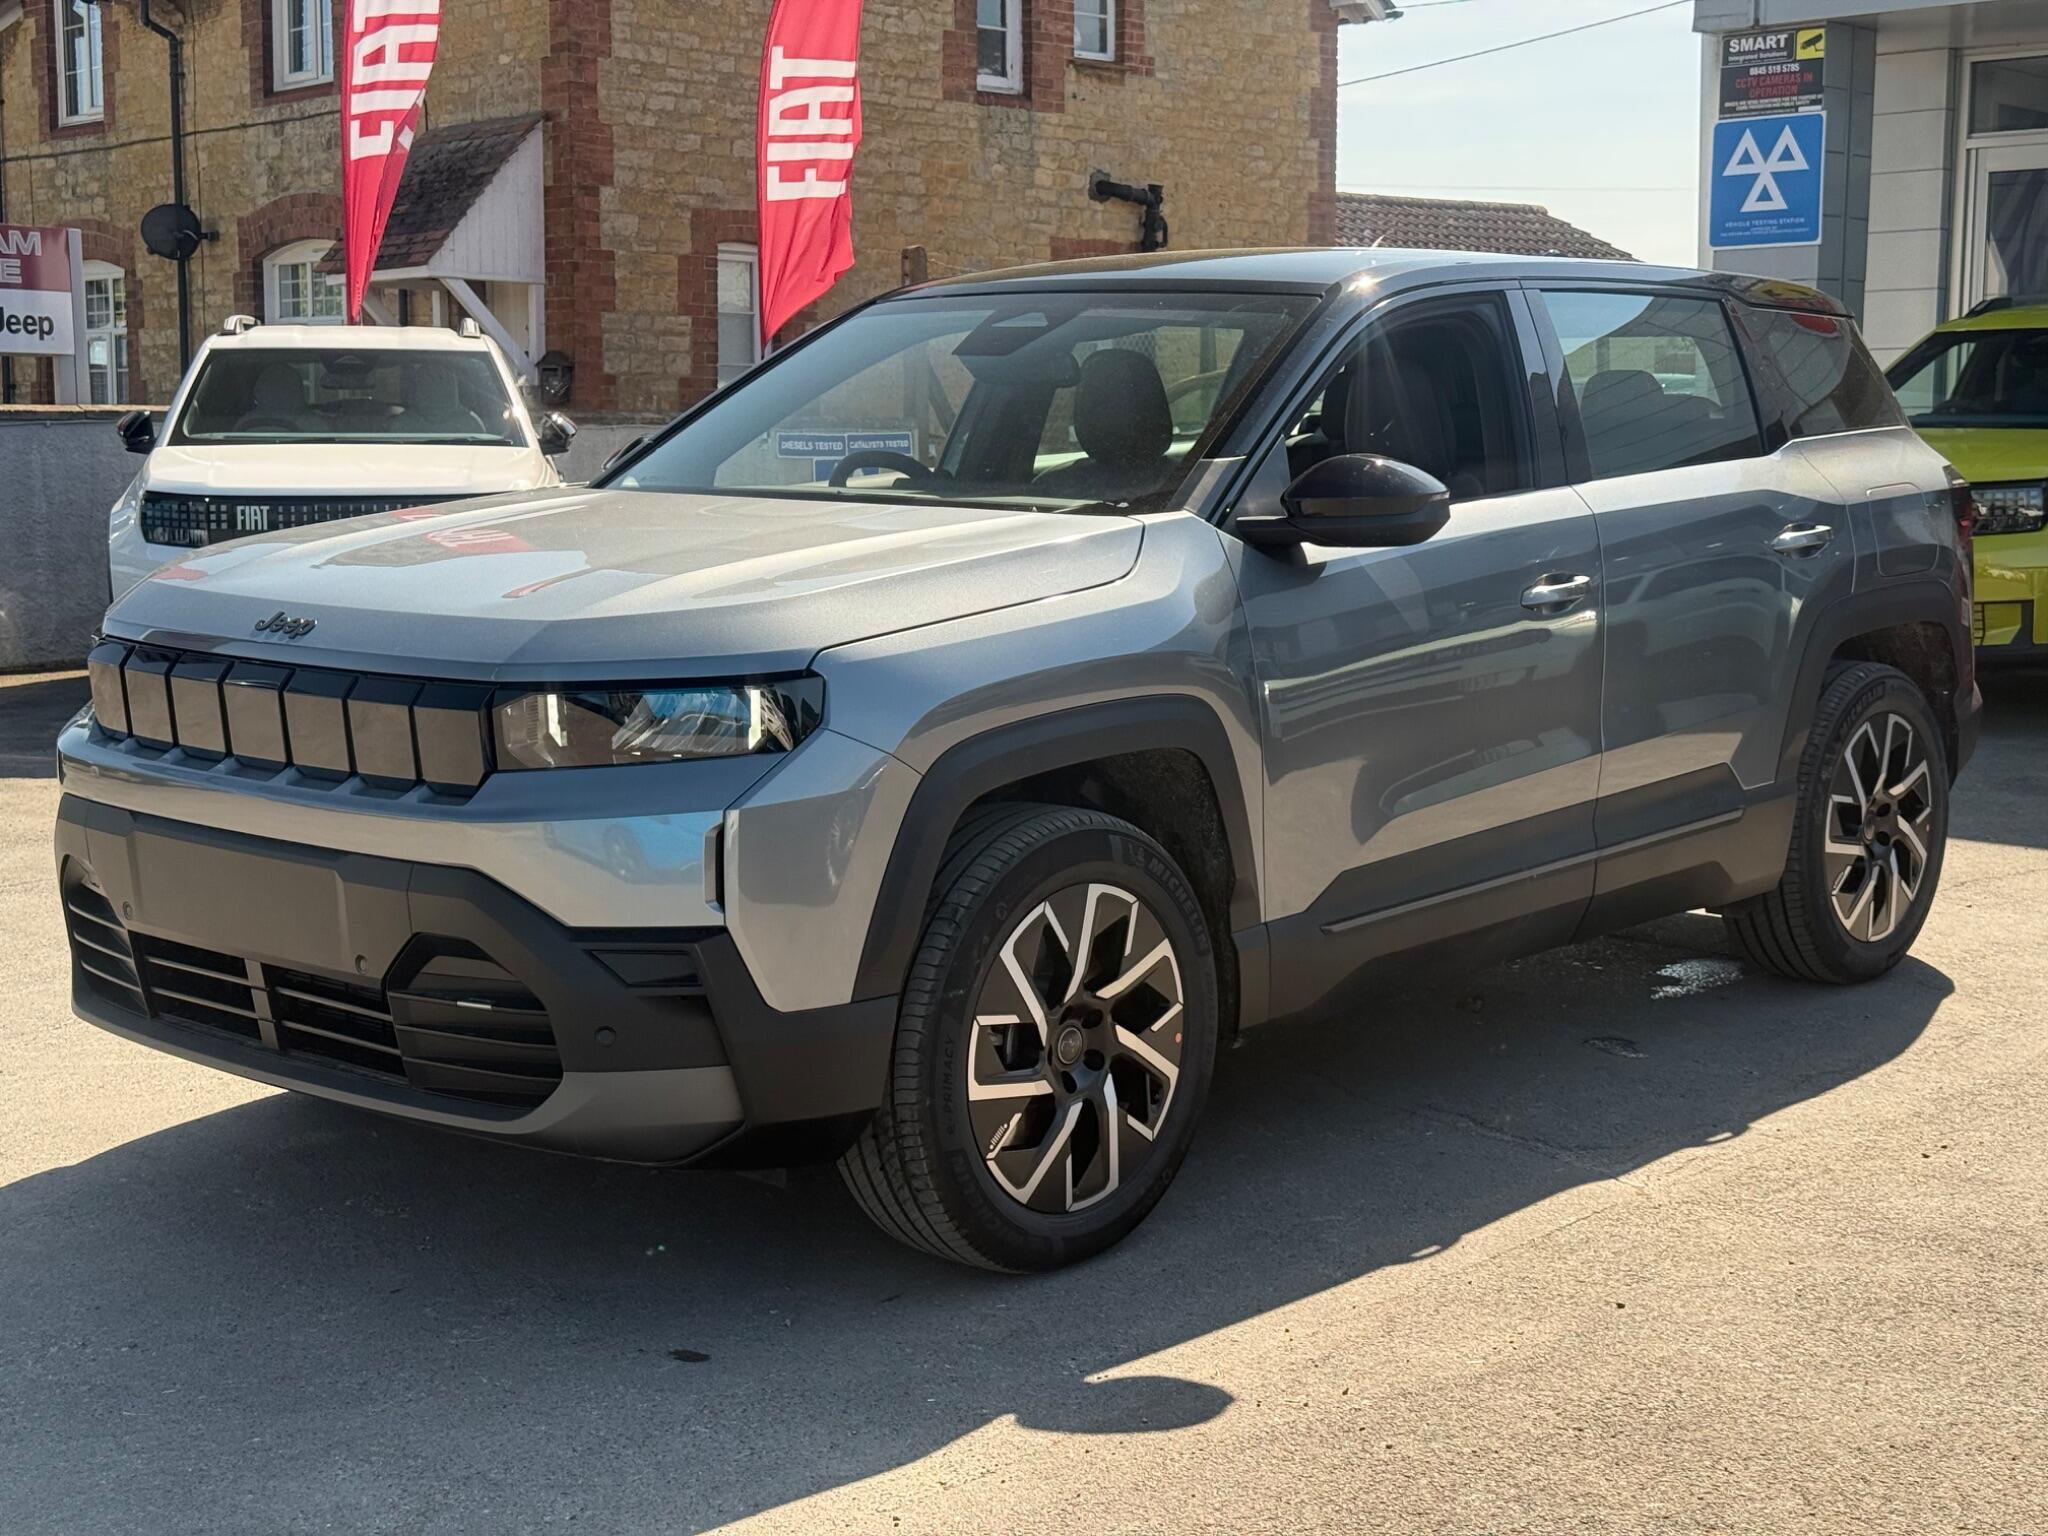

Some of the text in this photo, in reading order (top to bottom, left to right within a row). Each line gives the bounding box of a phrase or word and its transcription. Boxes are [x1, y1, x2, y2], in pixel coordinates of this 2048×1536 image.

[1729, 34, 1788, 53] SMART
[350, 0, 440, 160] FIAT
[1736, 72, 1813, 89] CCTV CAMERAS IN
[1749, 84, 1798, 98] OPERATION
[766, 46, 857, 201] FIAT
[781, 441, 843, 450] DIESELS TESTED
[849, 440, 909, 449] CATALYSTS TESTED
[236, 505, 270, 530] FIAT
[255, 611, 318, 640] Jeep
